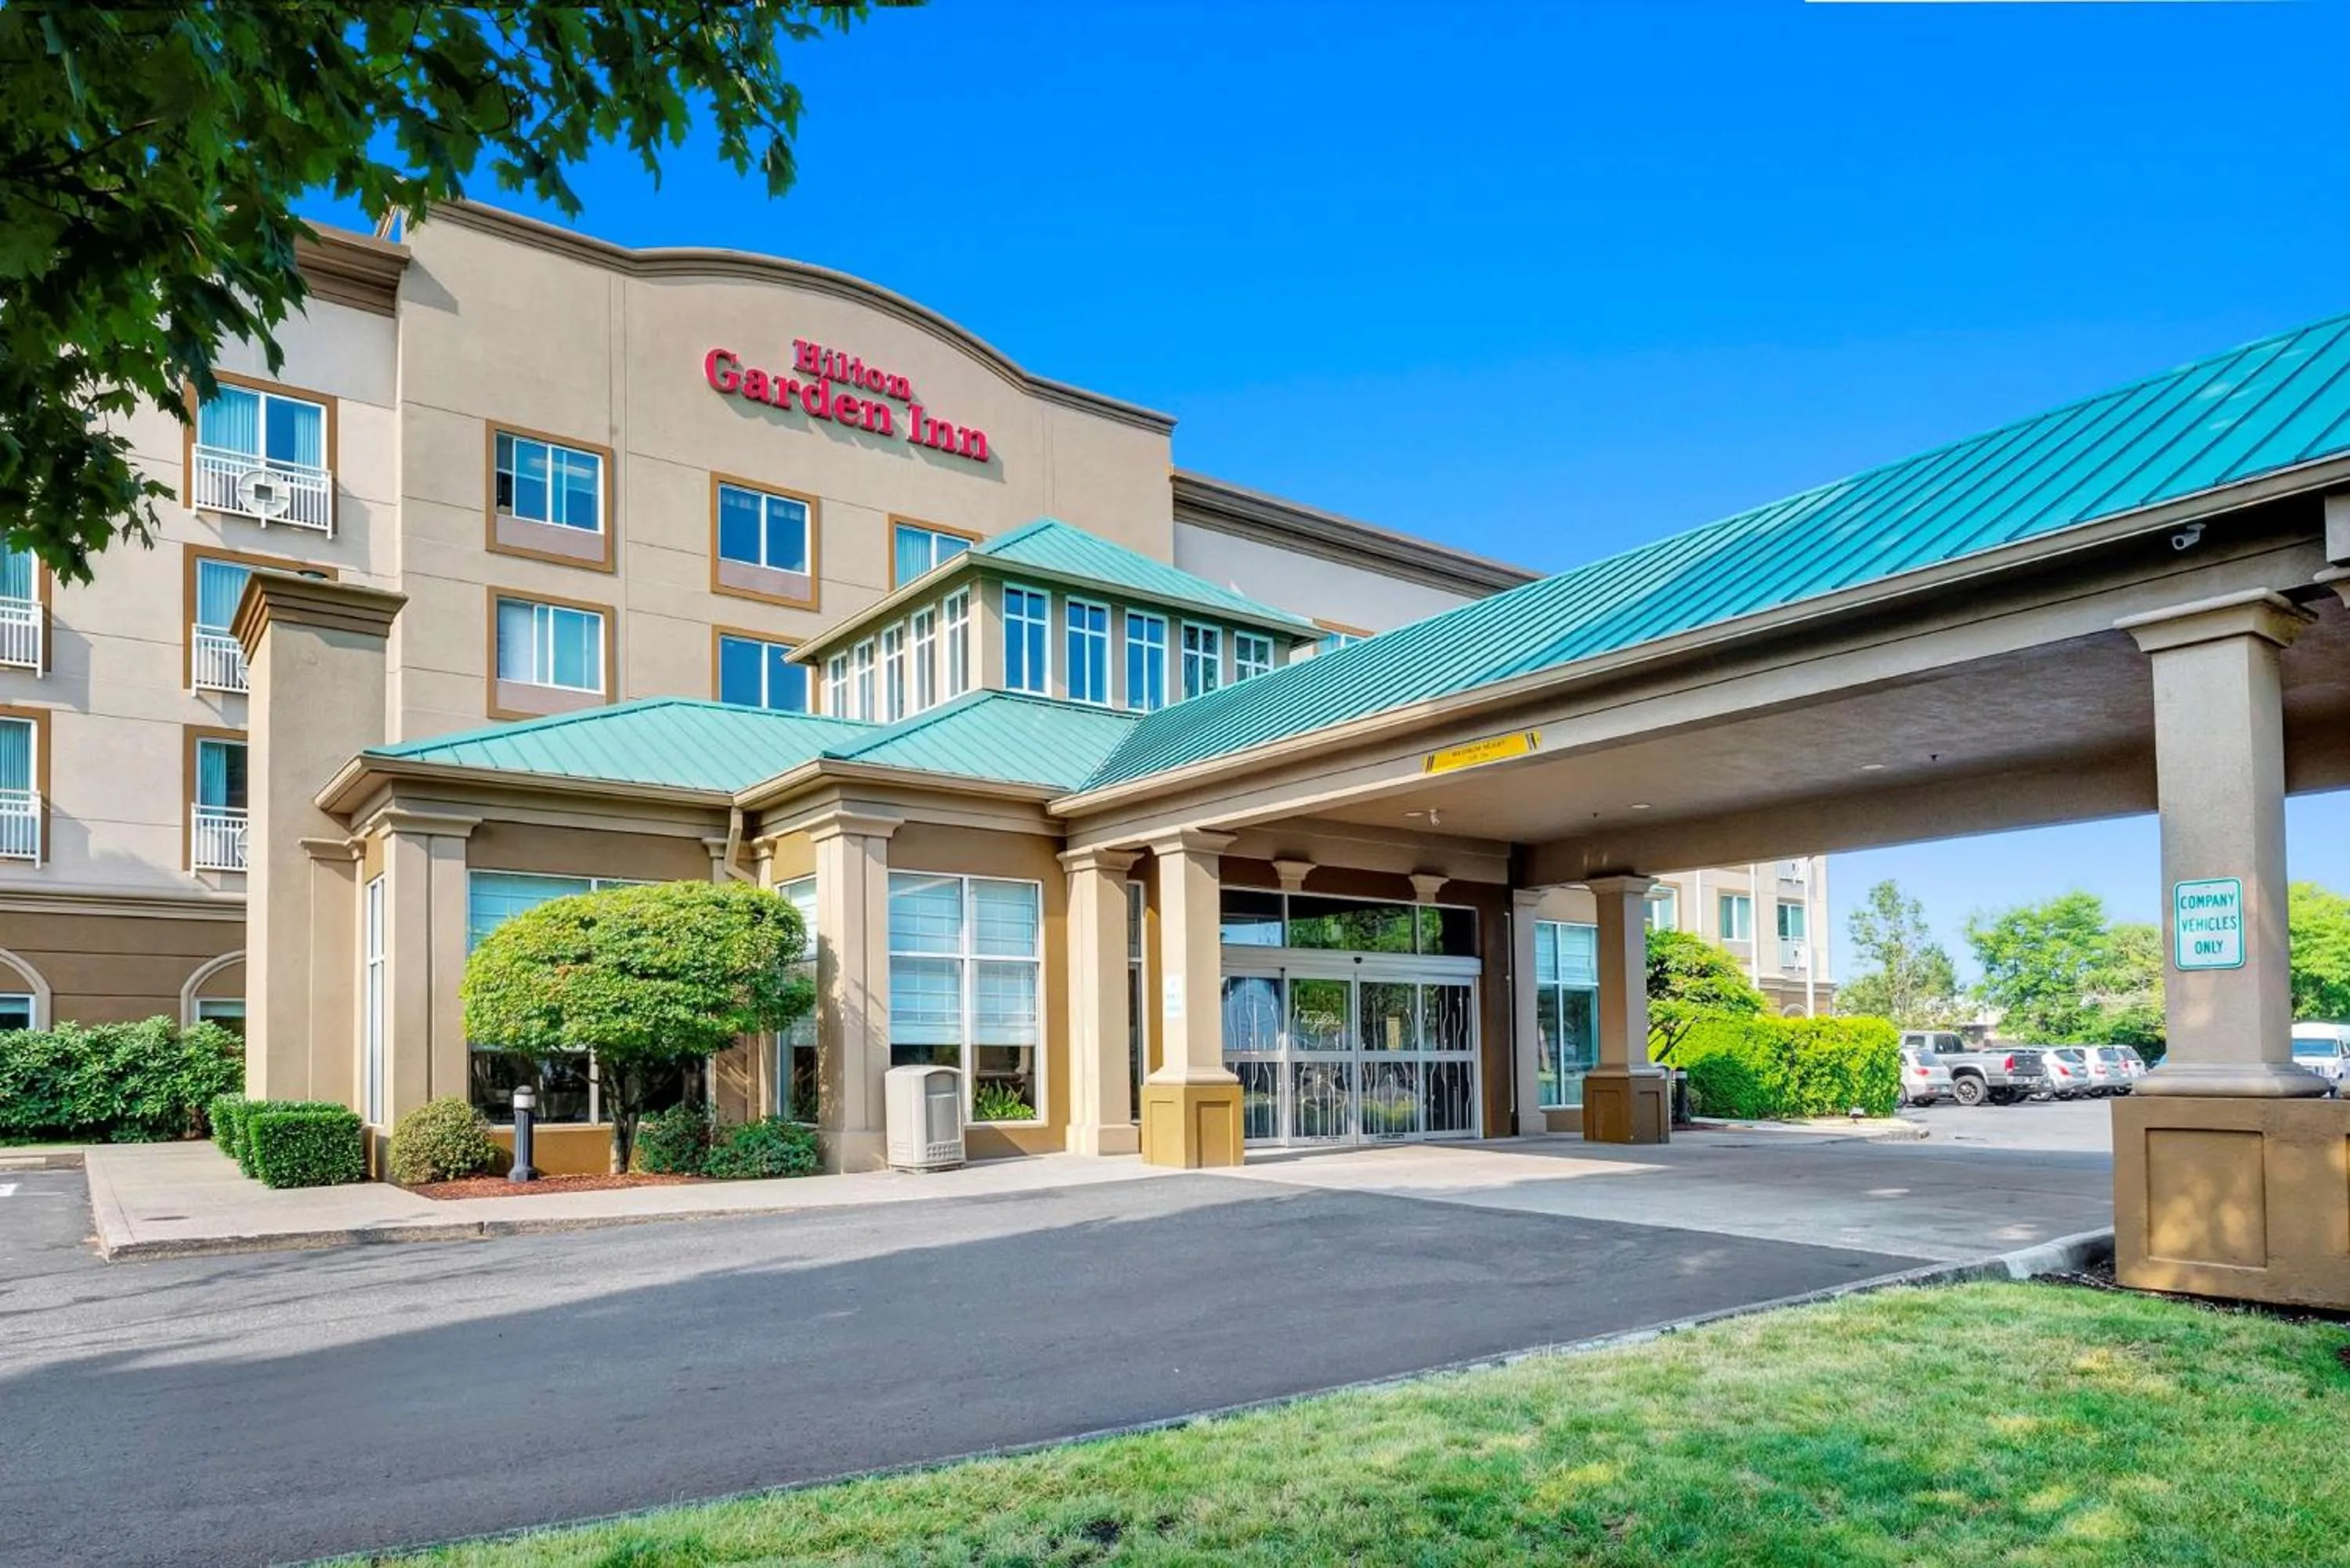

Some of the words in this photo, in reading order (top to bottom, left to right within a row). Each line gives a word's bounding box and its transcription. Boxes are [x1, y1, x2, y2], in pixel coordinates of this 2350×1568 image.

[792, 338, 912, 402] Hilton
[704, 347, 894, 436] Garden
[906, 401, 990, 463] Inn
[2180, 893, 2235, 909] COMPANY
[2182, 916, 2237, 932] VEHICLES
[2194, 940, 2223, 955] ONLY
